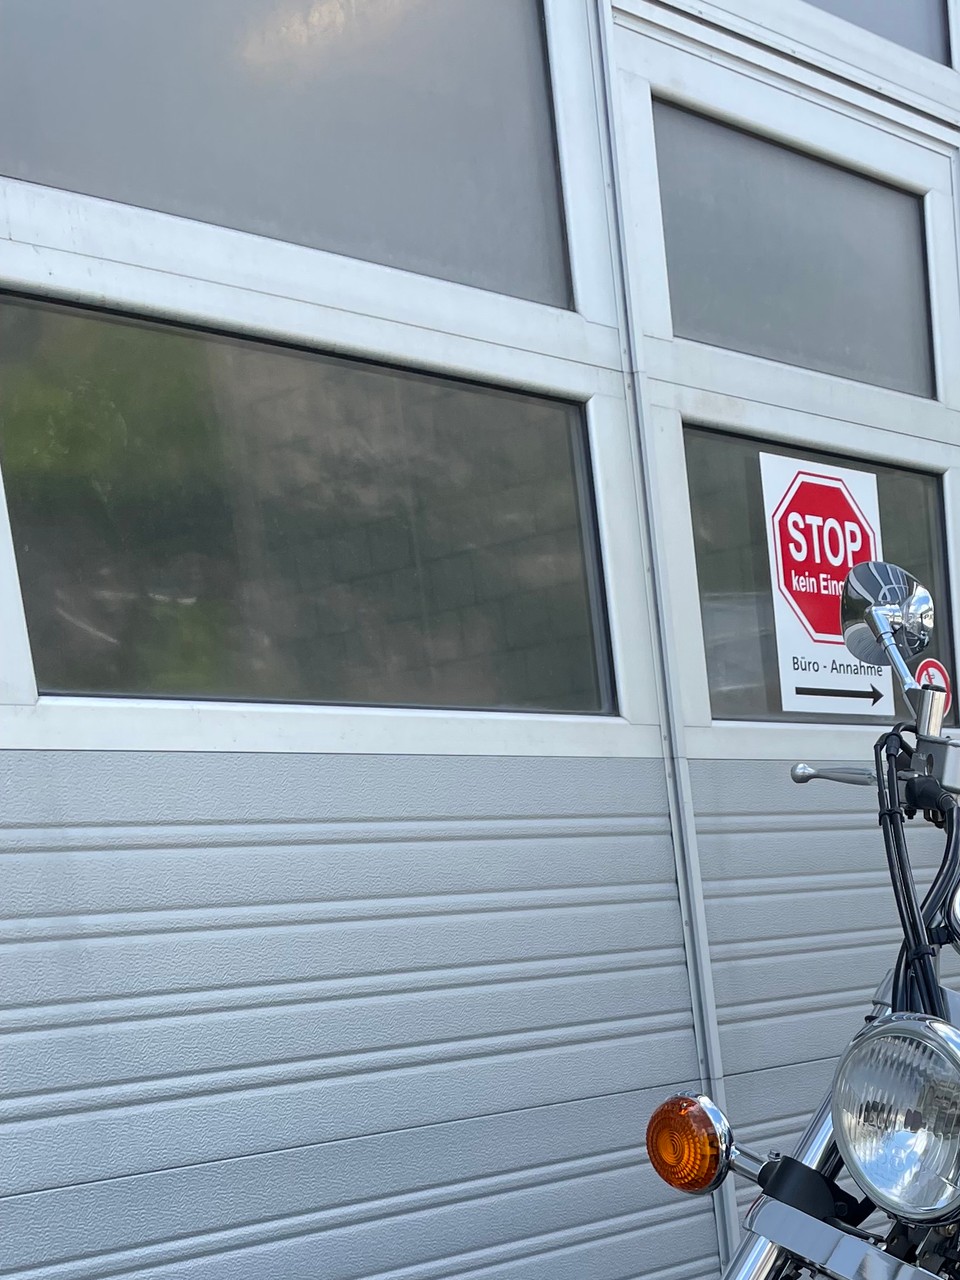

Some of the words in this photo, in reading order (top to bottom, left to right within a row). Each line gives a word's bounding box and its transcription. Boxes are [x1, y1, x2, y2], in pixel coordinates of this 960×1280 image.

[787, 511, 862, 568] STOP
[791, 569, 818, 594] kein
[792, 656, 820, 672] Büro
[830, 659, 883, 677] Annahme
